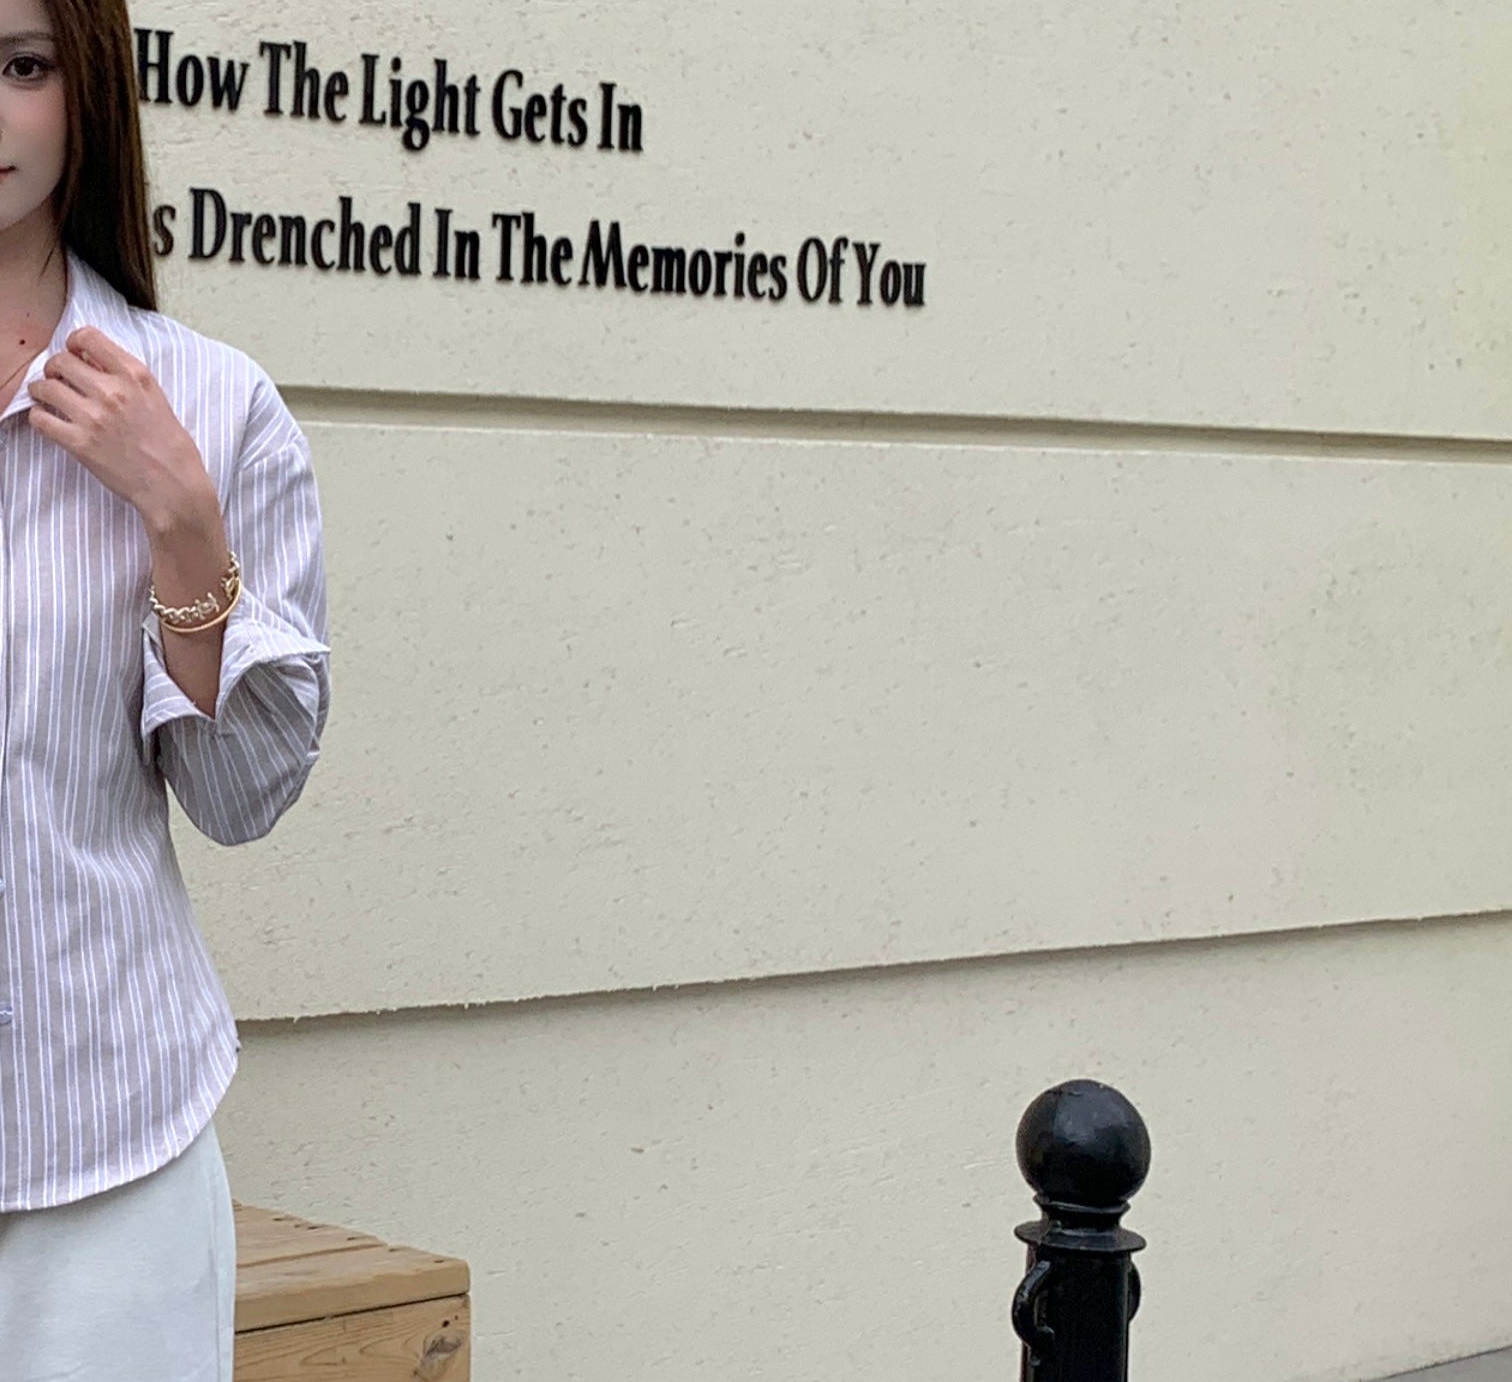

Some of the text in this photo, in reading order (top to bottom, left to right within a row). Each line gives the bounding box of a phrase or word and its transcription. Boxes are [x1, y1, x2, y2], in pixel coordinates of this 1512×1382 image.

[134, 27, 250, 113] How
[258, 39, 349, 124] The
[358, 53, 481, 154] Light
[491, 68, 588, 149] Gets
[597, 82, 643, 154] In
[188, 186, 422, 278] Drenched
[432, 208, 481, 282] In
[491, 212, 574, 288] The
[577, 218, 788, 303] Memories
[796, 236, 849, 305] Of
[852, 241, 926, 308] You
